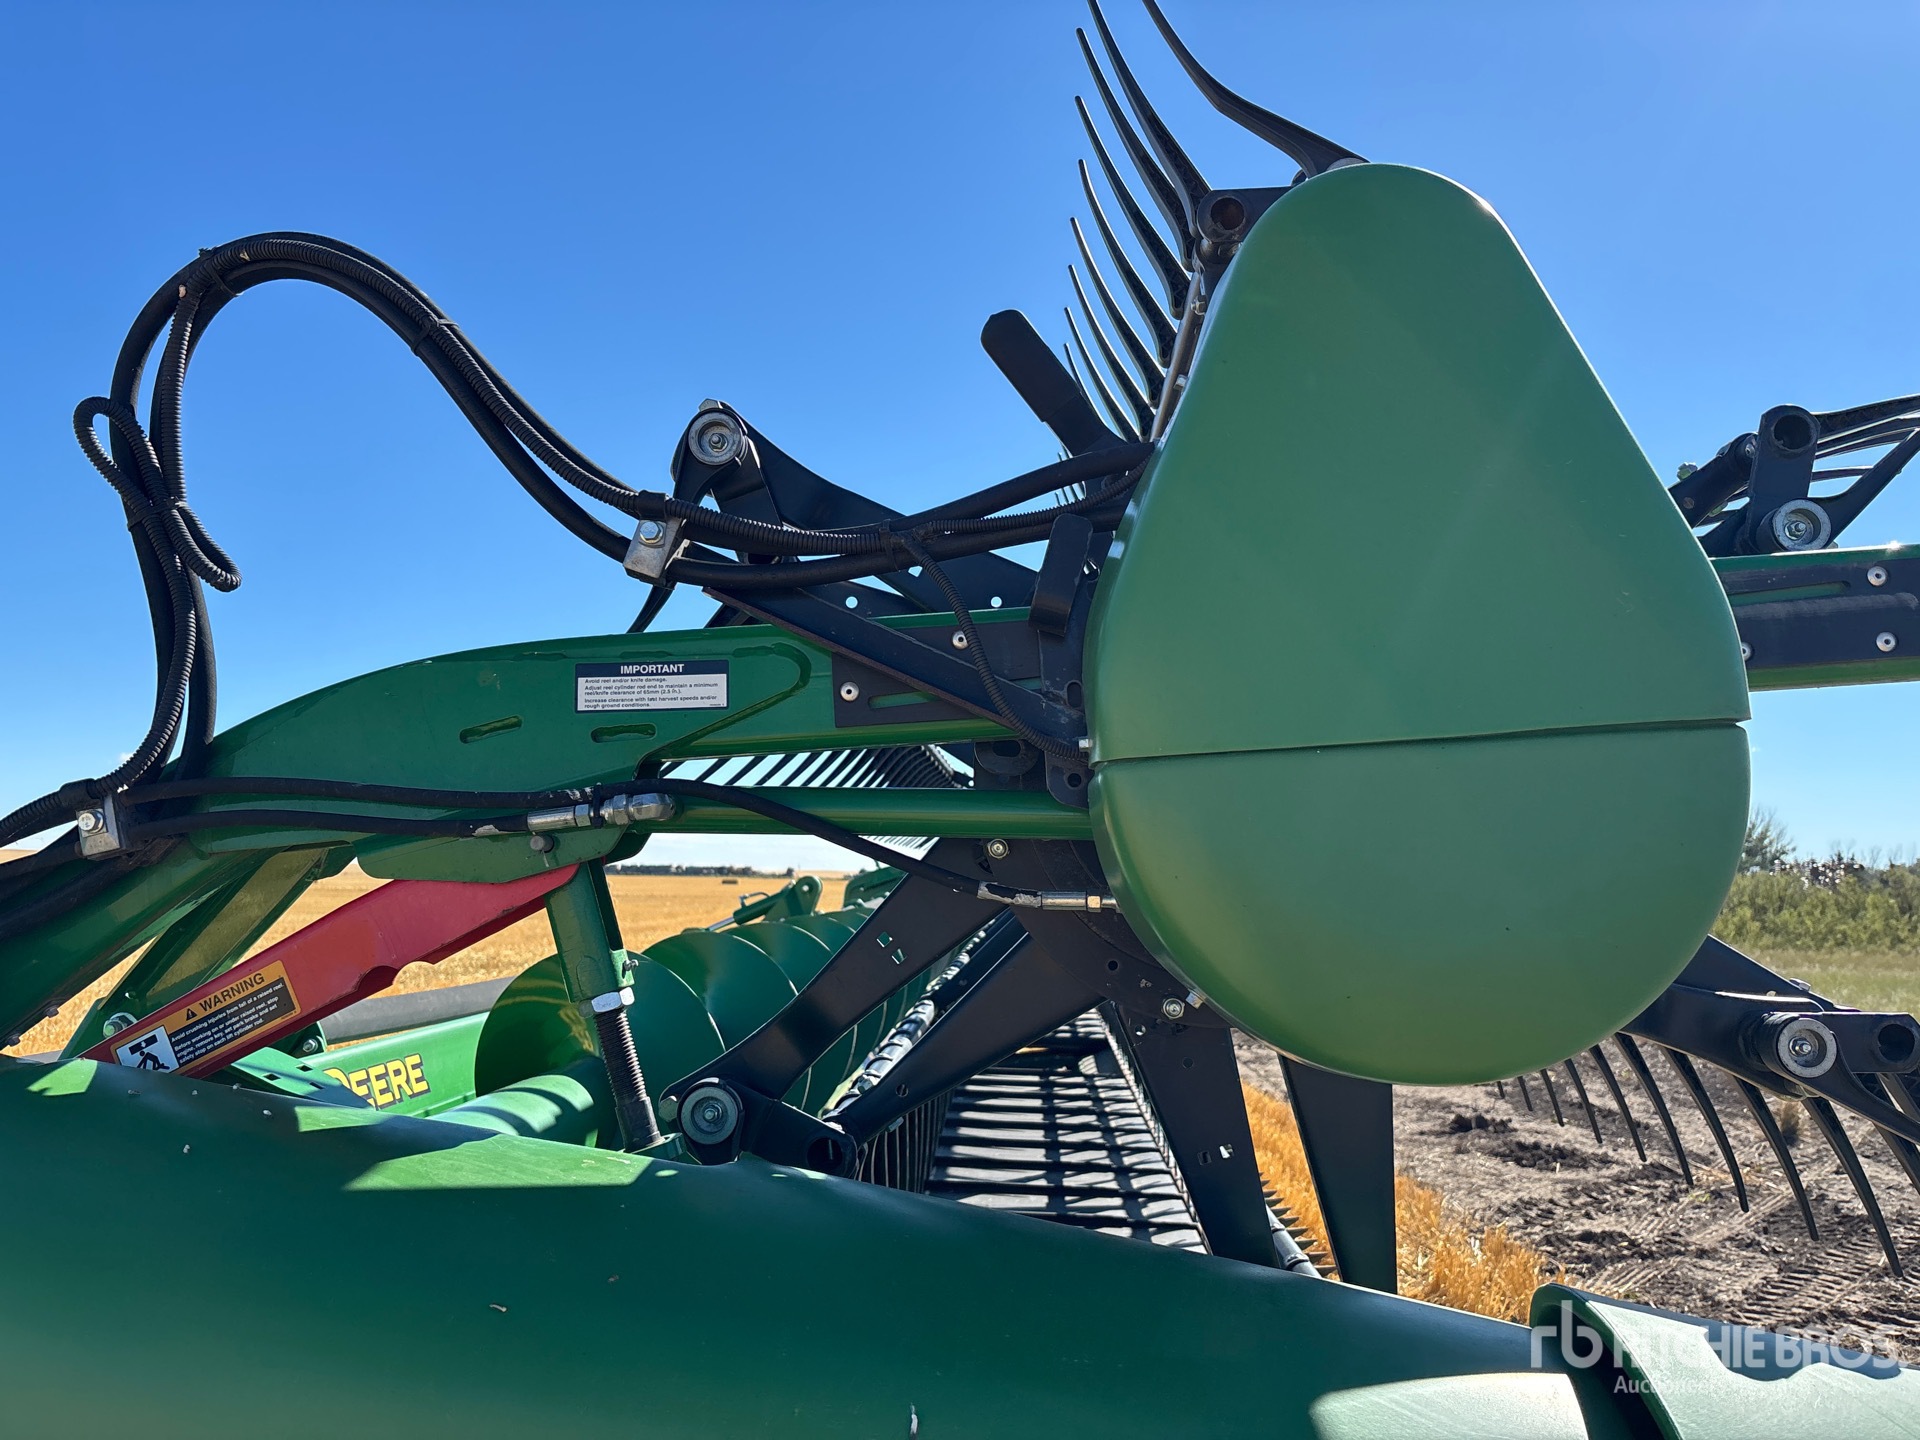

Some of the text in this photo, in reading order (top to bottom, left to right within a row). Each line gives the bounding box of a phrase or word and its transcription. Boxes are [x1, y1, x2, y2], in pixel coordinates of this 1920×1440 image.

[620, 664, 685, 674] IMPORTANT
[171, 1032, 186, 1043] Avoid
[186, 1020, 209, 1036] crushing
[208, 1012, 227, 1024] injuries
[226, 1006, 239, 1015] from
[238, 1000, 248, 1009] fall
[256, 988, 273, 1000] raised
[273, 982, 284, 992] reel.
[199, 972, 265, 1012] WARNING
[174, 1040, 192, 1052] Before
[191, 1030, 212, 1043] working
[225, 1016, 240, 1026] under
[240, 1006, 256, 1018] raised
[266, 996, 279, 1005] stop
[180, 1053, 195, 1064] safety
[194, 1047, 207, 1056] stop
[214, 1037, 227, 1046] each
[233, 1023, 254, 1037] cylinder
[195, 1036, 214, 1048] remove
[224, 1026, 233, 1034] set
[232, 1020, 244, 1030] park
[244, 1014, 259, 1024] brake
[258, 1008, 269, 1016] and
[268, 1003, 278, 1012] set
